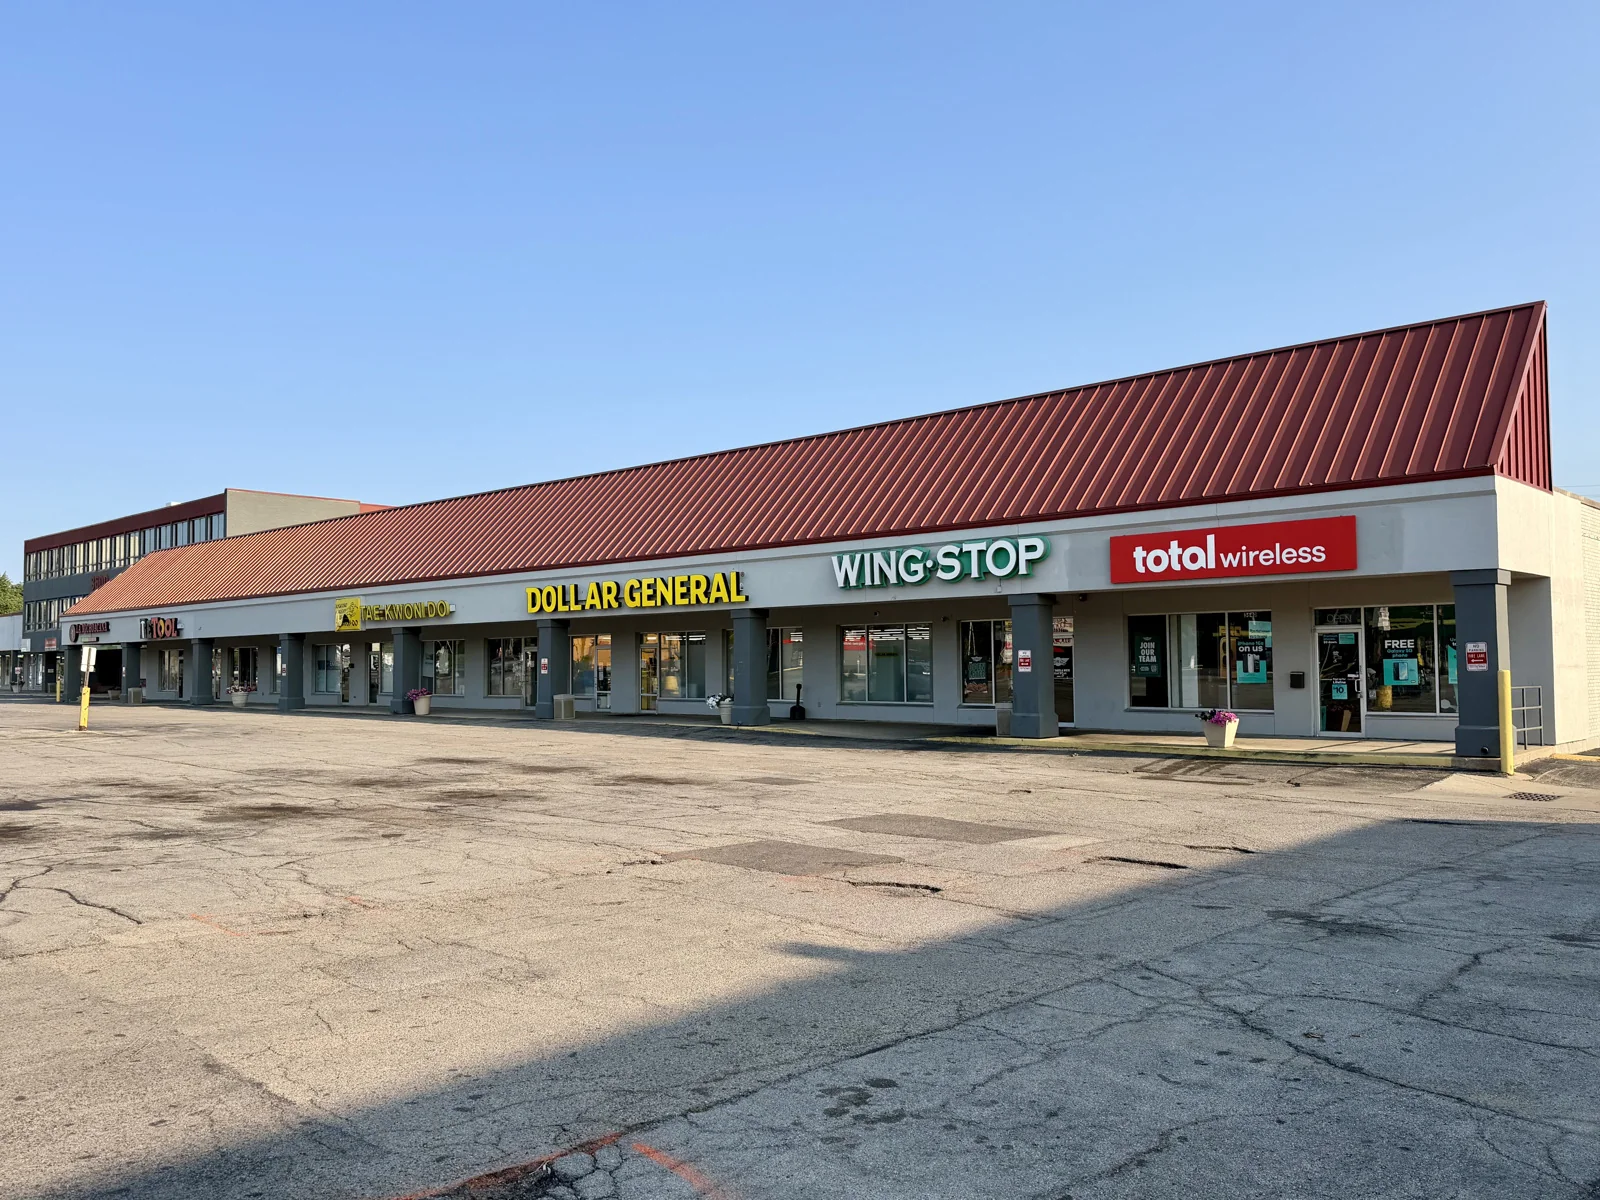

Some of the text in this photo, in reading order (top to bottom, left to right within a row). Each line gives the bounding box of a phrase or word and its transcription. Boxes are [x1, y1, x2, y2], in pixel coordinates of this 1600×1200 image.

[1133, 533, 1326, 574] total wireless
[525, 571, 746, 614] DOLLAR GENERAL
[360, 604, 381, 621] TAE
[384, 602, 424, 620] KWON
[427, 600, 448, 618] DO
[1139, 641, 1156, 649] JOIN
[1384, 639, 1415, 649] FREE
[1140, 648, 1155, 656] OUR
[1138, 655, 1157, 663] TEAM
